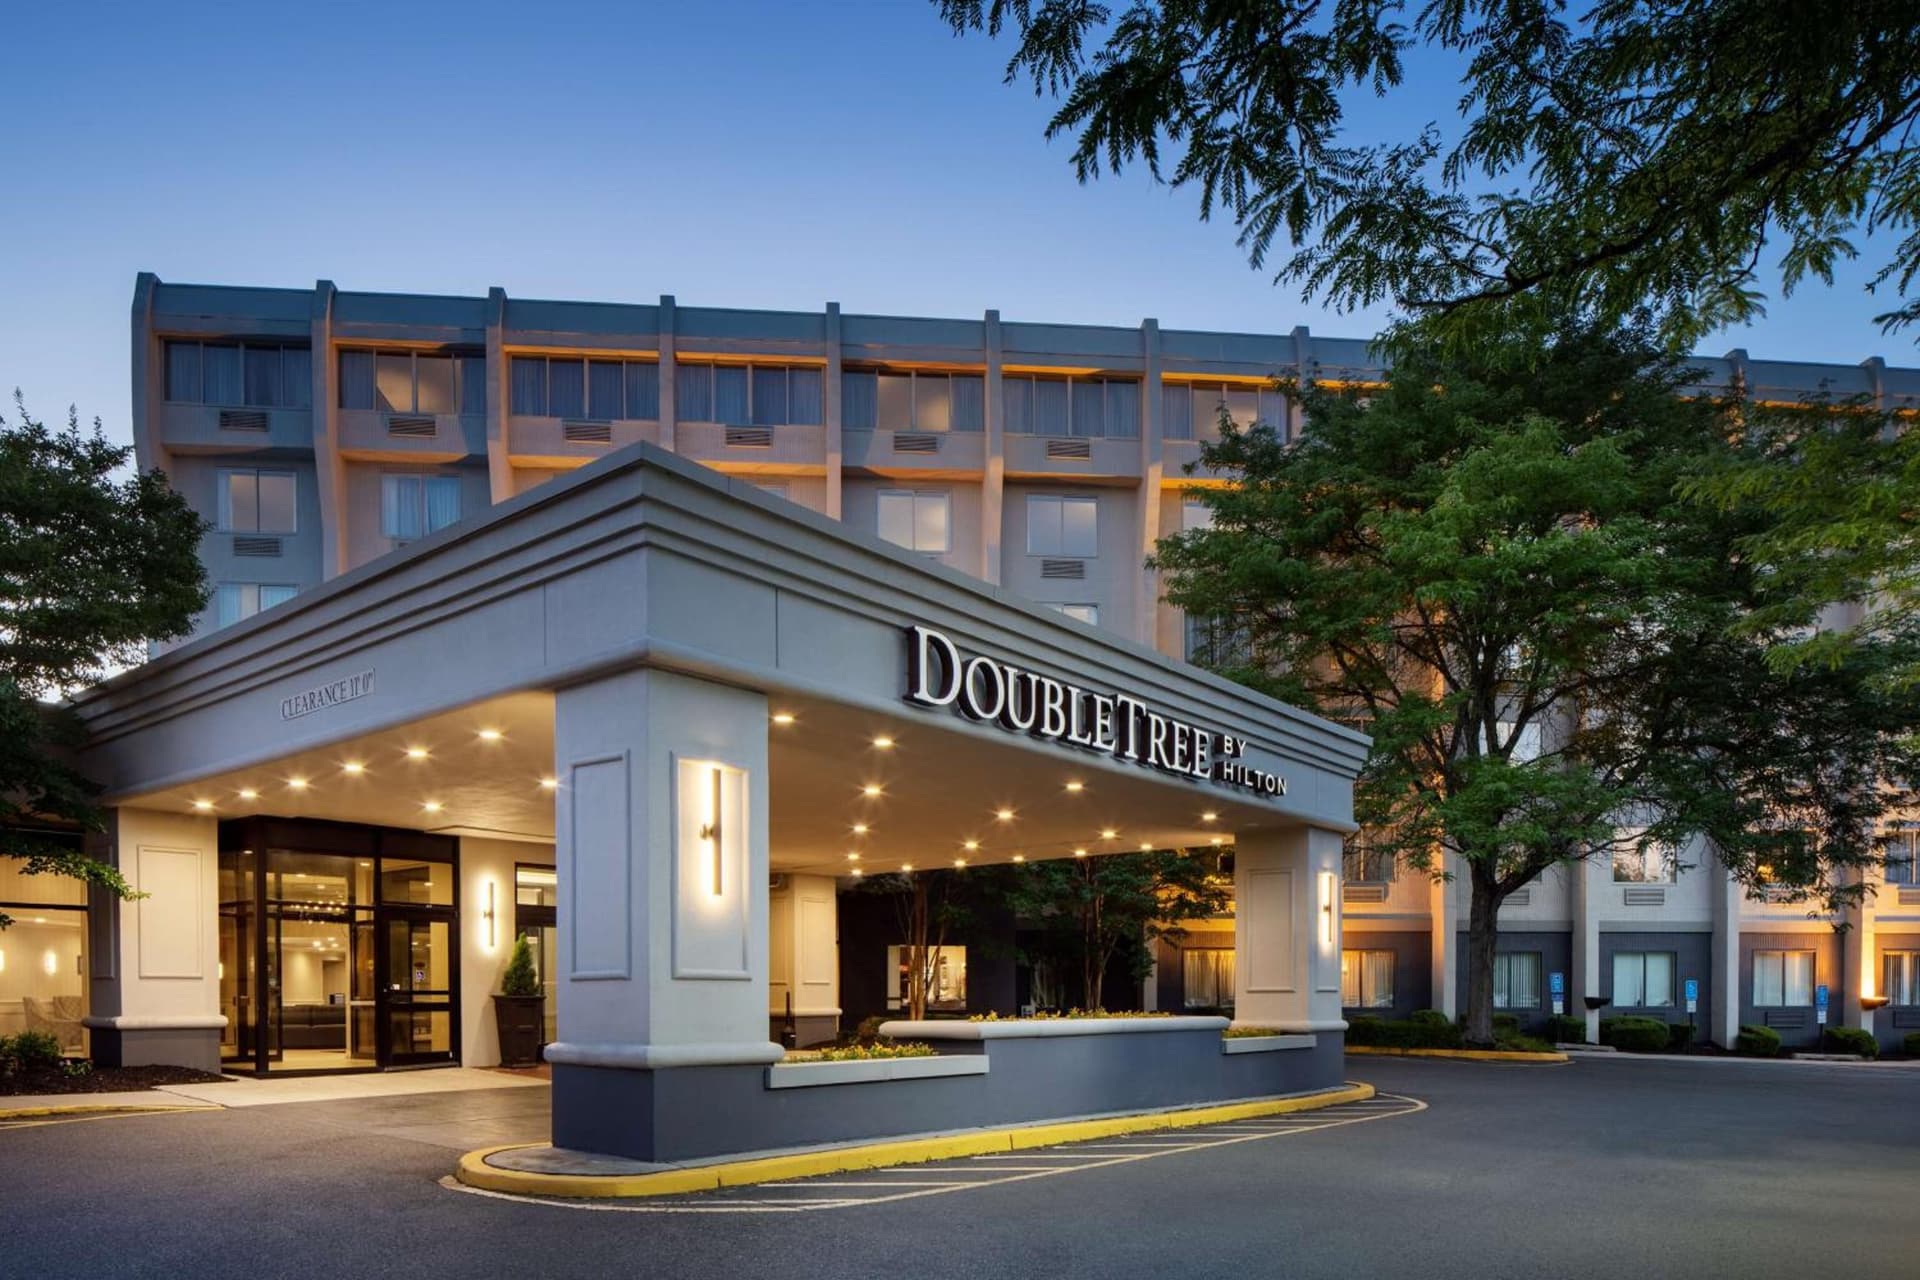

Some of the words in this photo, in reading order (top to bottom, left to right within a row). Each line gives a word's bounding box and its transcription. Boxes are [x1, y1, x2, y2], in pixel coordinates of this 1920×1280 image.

[281, 681, 347, 719] CLEARANCE
[913, 625, 1211, 779] DOUBLETREE
[1223, 734, 1247, 757] BY
[1223, 760, 1287, 795] HILTON
